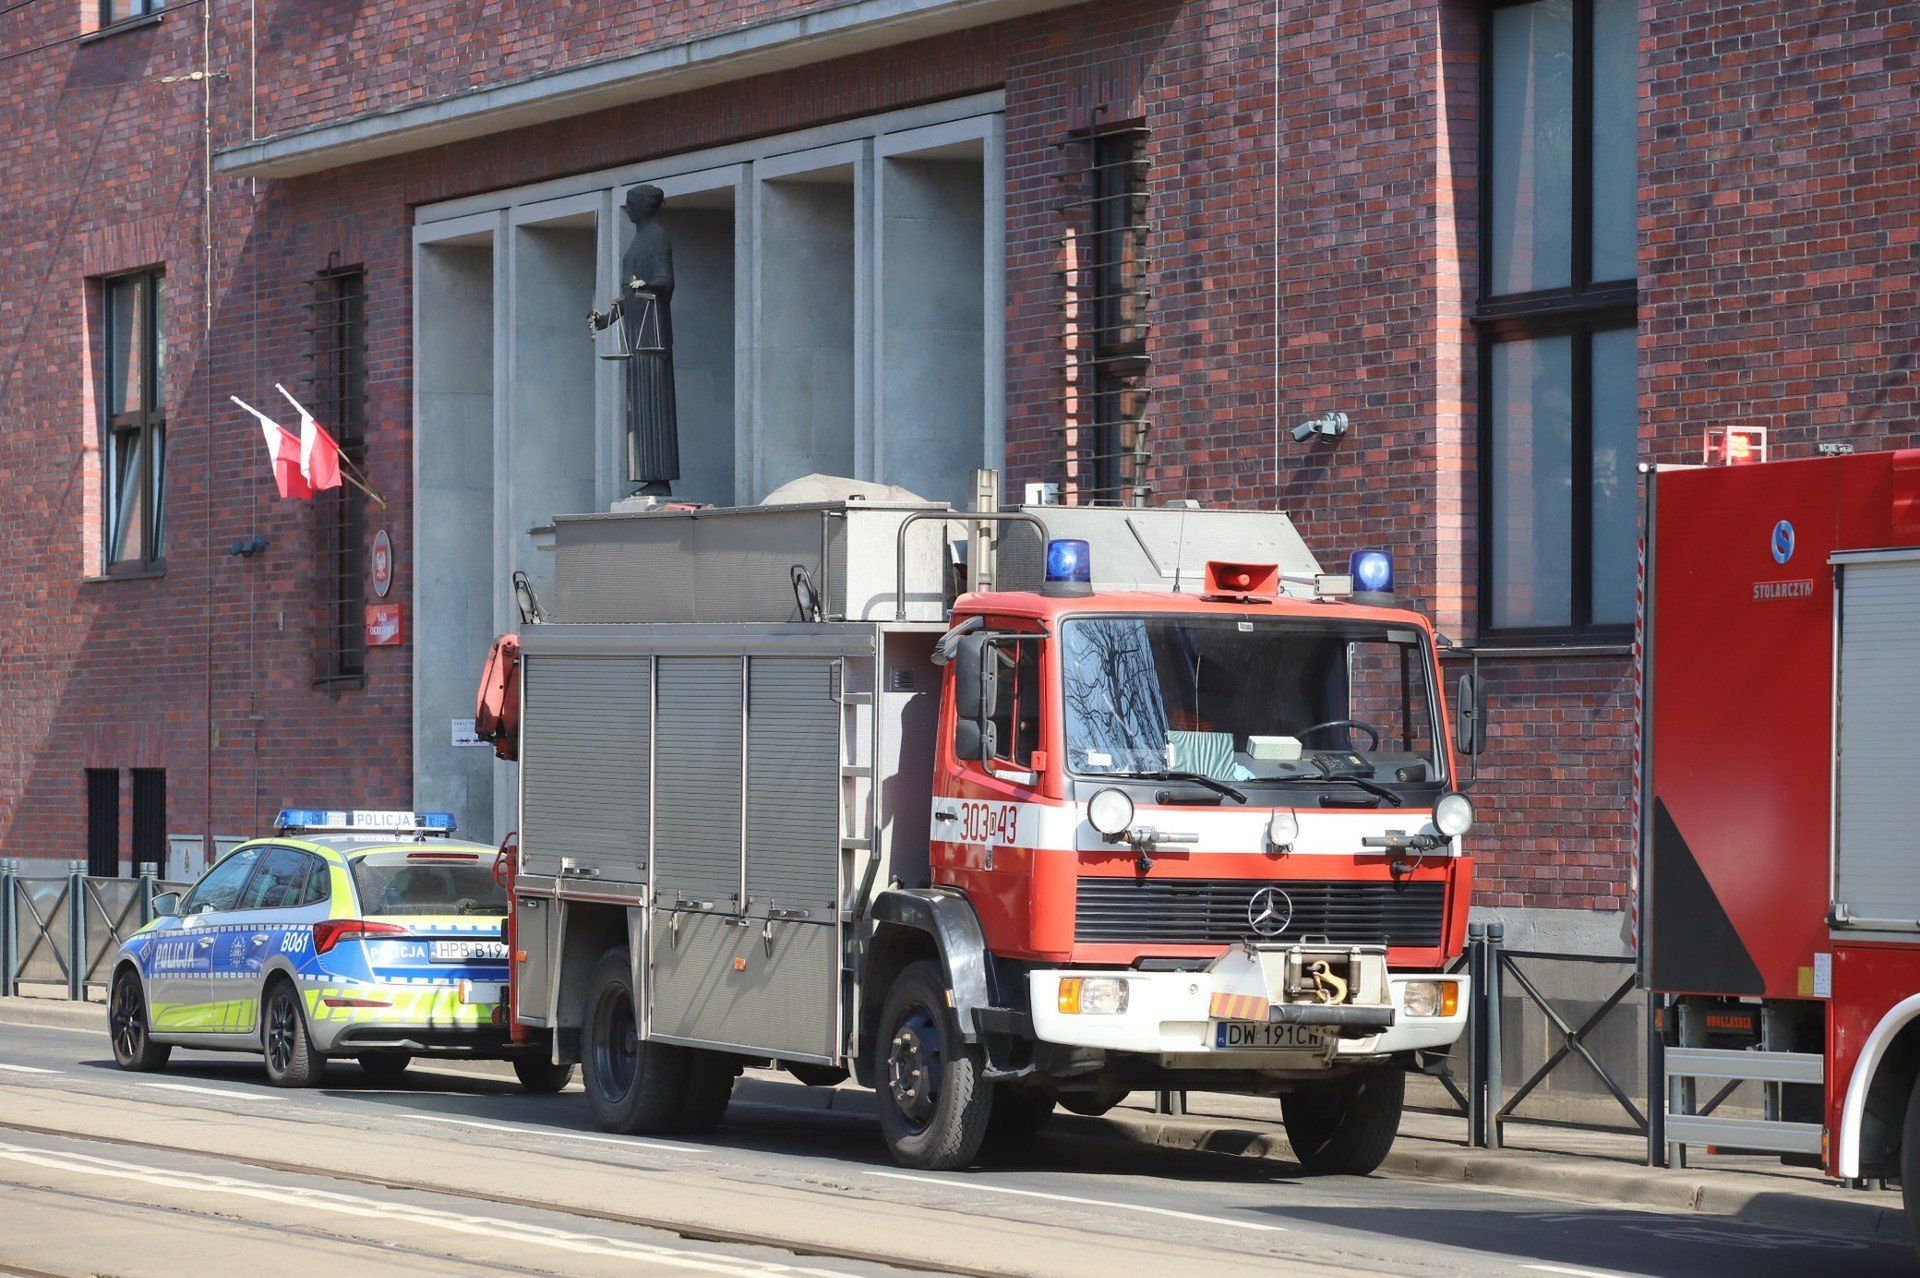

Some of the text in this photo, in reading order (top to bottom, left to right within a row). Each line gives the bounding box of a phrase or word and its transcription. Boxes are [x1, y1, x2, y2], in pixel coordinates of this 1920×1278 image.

[1753, 582, 1811, 599] STOLARCZYK
[357, 813, 411, 826] POLICJA
[280, 932, 310, 953] B061
[440, 942, 470, 957] HPB
[154, 941, 196, 969] POLICJA
[1229, 1024, 1256, 1045] DW
